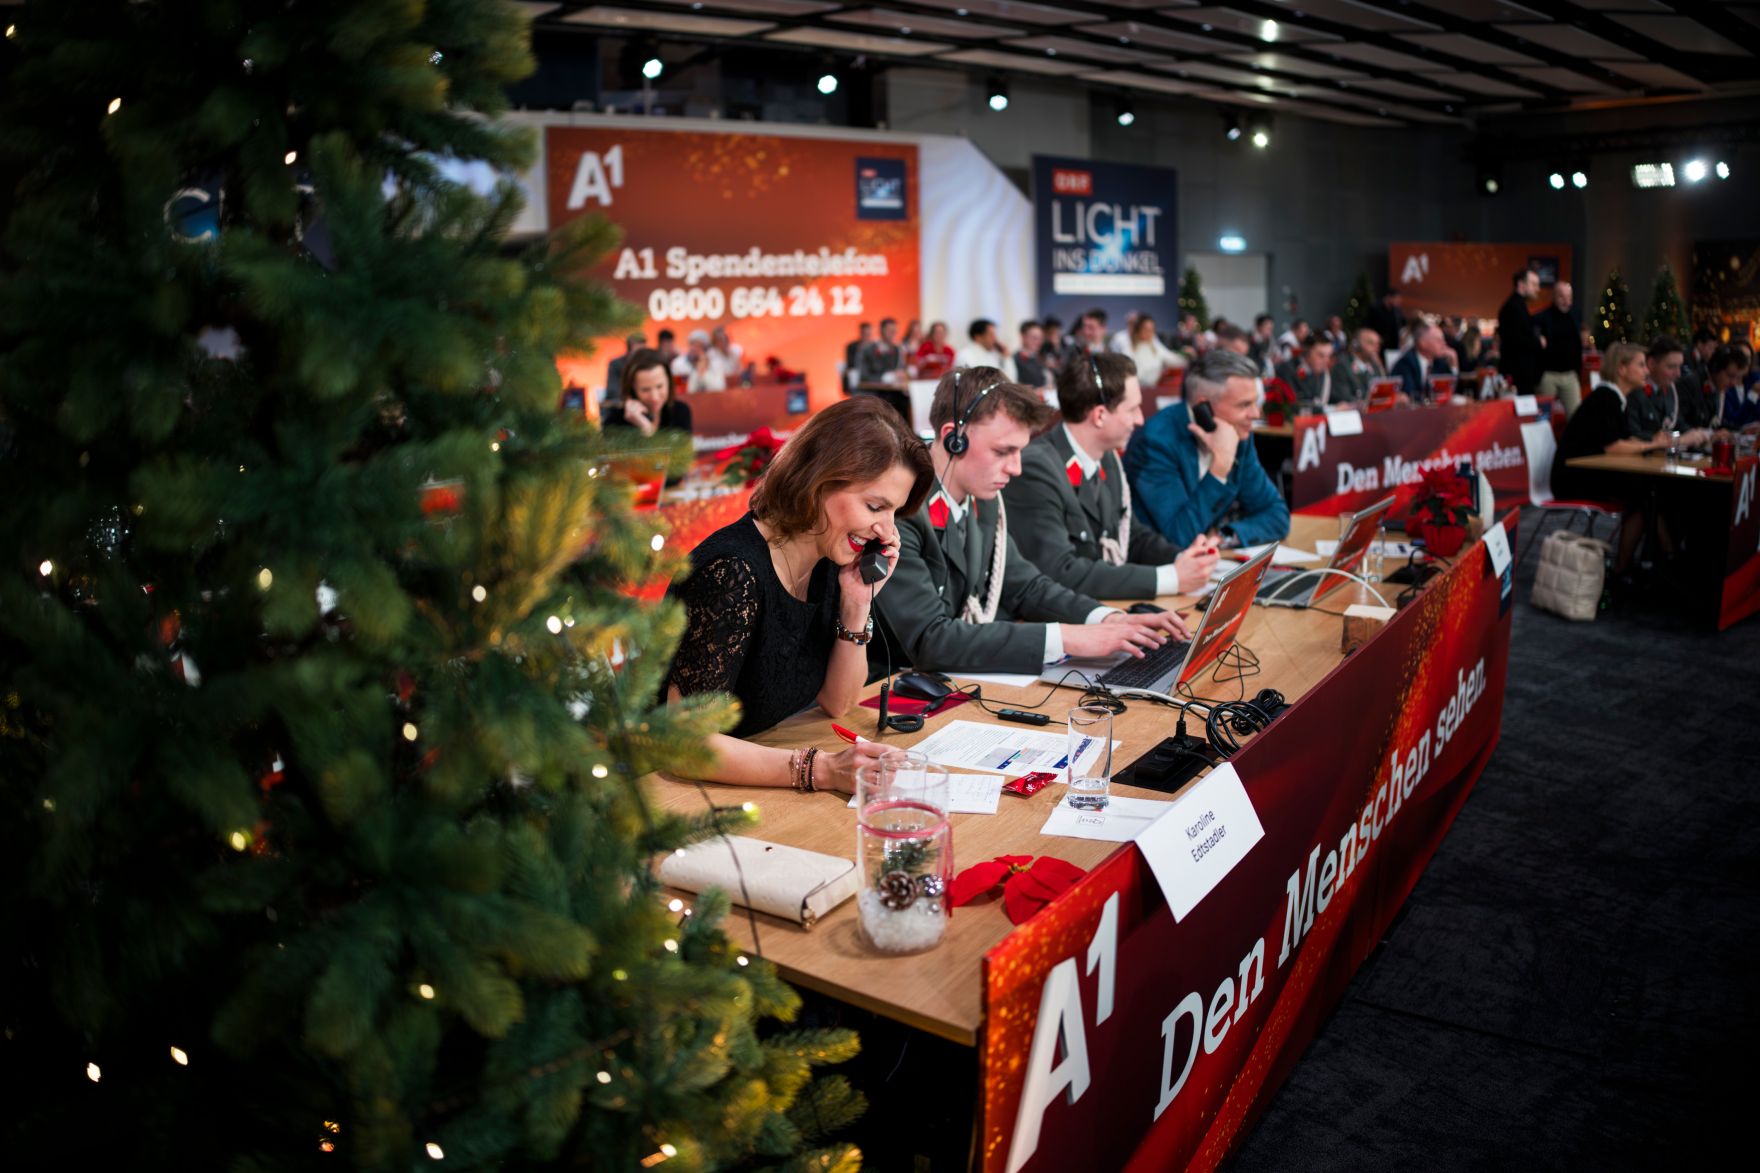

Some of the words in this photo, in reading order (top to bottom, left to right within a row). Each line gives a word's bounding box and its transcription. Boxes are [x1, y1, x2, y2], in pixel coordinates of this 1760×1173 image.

[566, 144, 624, 211] A1
[1052, 199, 1162, 247] LICHT
[613, 248, 658, 280] A1
[666, 246, 889, 285] Spendentelefon
[1053, 247, 1085, 272] INS
[1402, 253, 1429, 284] A1
[648, 287, 725, 322] 0800
[730, 286, 784, 319] 664
[789, 285, 824, 317] 24
[829, 285, 863, 316] 12
[1297, 421, 1326, 472] A1
[1336, 461, 1379, 495] Den
[1735, 463, 1757, 527] A1
[1185, 810, 1216, 841] Karoline
[1191, 824, 1227, 863] Edtstadler
[1153, 937, 1265, 1123] Den
[1277, 729, 1431, 969] Menschen
[1434, 657, 1487, 759] sehen.
[1004, 890, 1119, 1173] A1
